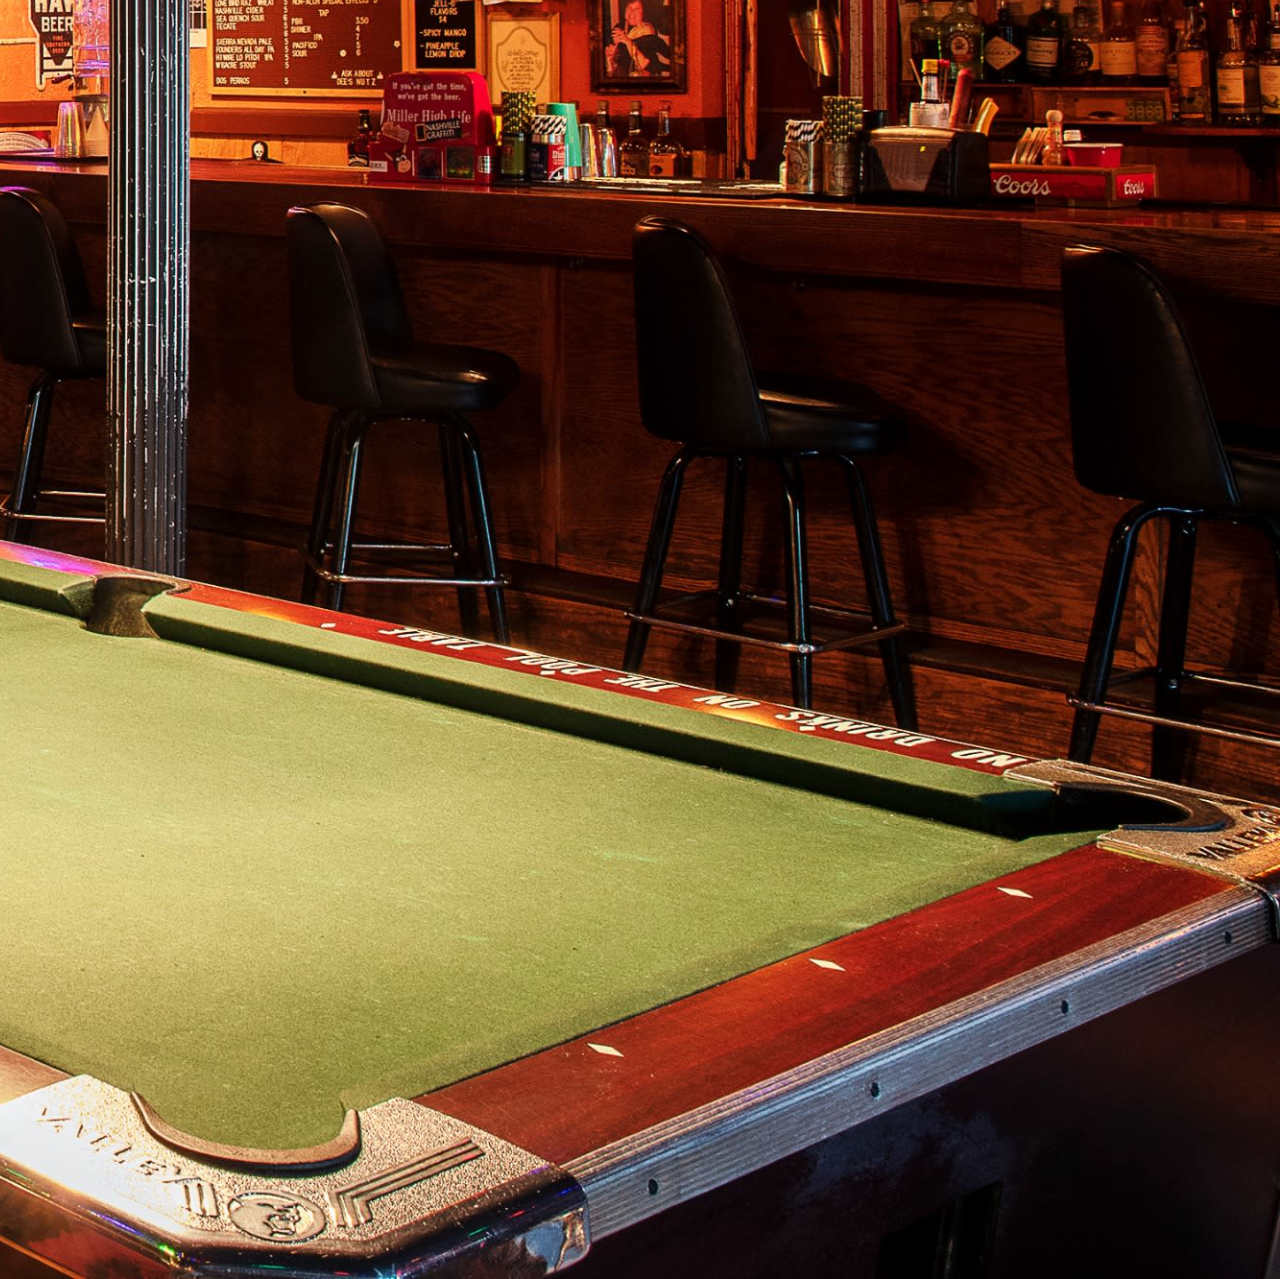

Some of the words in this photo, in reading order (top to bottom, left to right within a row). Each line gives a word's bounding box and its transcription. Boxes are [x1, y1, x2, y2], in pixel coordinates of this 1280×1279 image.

[41, 16, 73, 32] BEER
[444, 28, 467, 36] MANGO
[425, 50, 447, 58] LEMON
[449, 50, 466, 58] DROP
[400, 82, 420, 91] you've
[423, 82, 433, 91] got
[417, 93, 429, 101] got
[387, 109, 419, 122] Miller
[422, 109, 447, 122] High
[451, 109, 471, 123] Life
[426, 120, 460, 130] NASHVILLE
[993, 174, 1051, 195] Coors
[378, 627, 487, 651] TABLE
[505, 652, 602, 676] POOL
[604, 675, 680, 693] THE
[693, 694, 761, 710] ON
[775, 710, 938, 748] DRINKS
[951, 748, 1027, 768] NO
